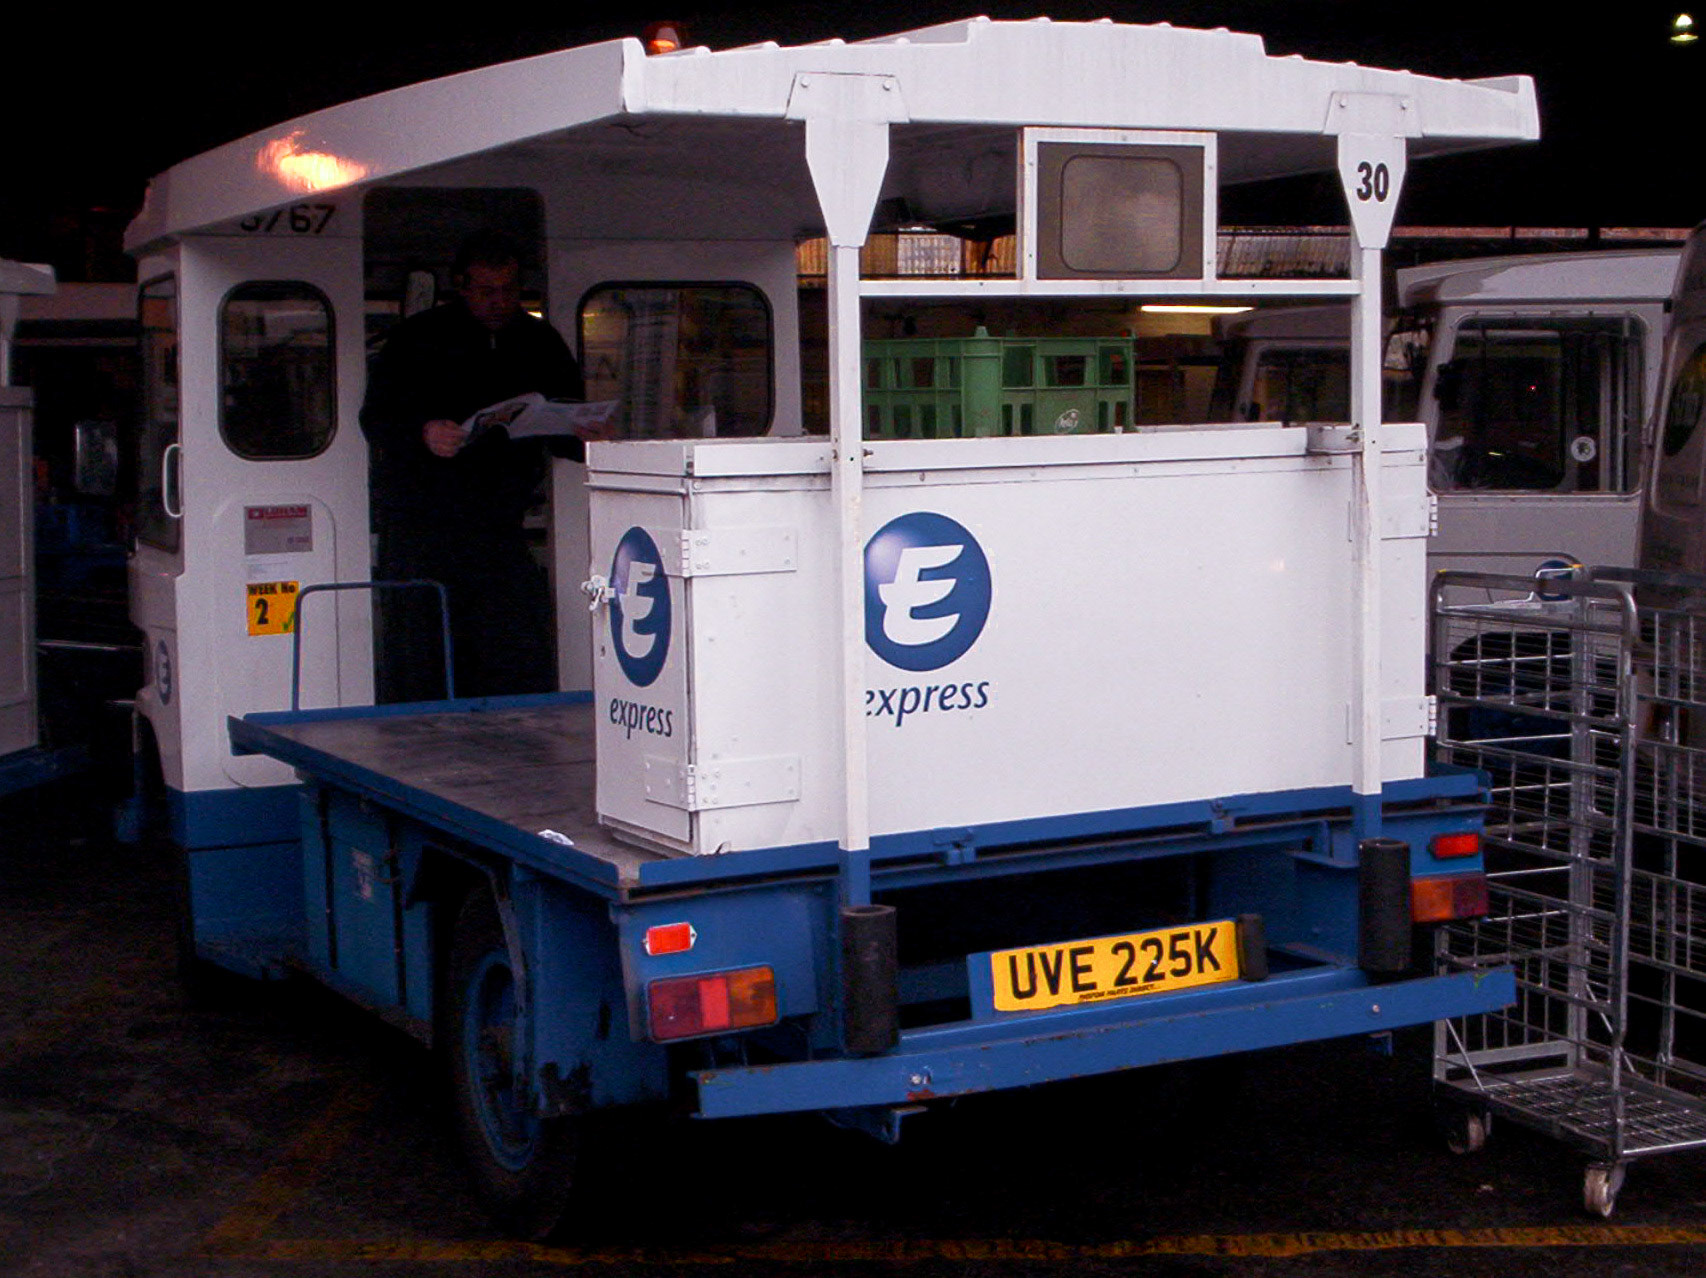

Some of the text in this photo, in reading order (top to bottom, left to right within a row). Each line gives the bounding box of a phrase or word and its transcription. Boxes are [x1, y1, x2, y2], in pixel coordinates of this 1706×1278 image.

[1357, 161, 1389, 202] 30
[248, 582, 277, 595] WEEK
[255, 598, 269, 625] 2
[609, 697, 673, 740] express
[1009, 928, 1221, 999] UVE 225K
